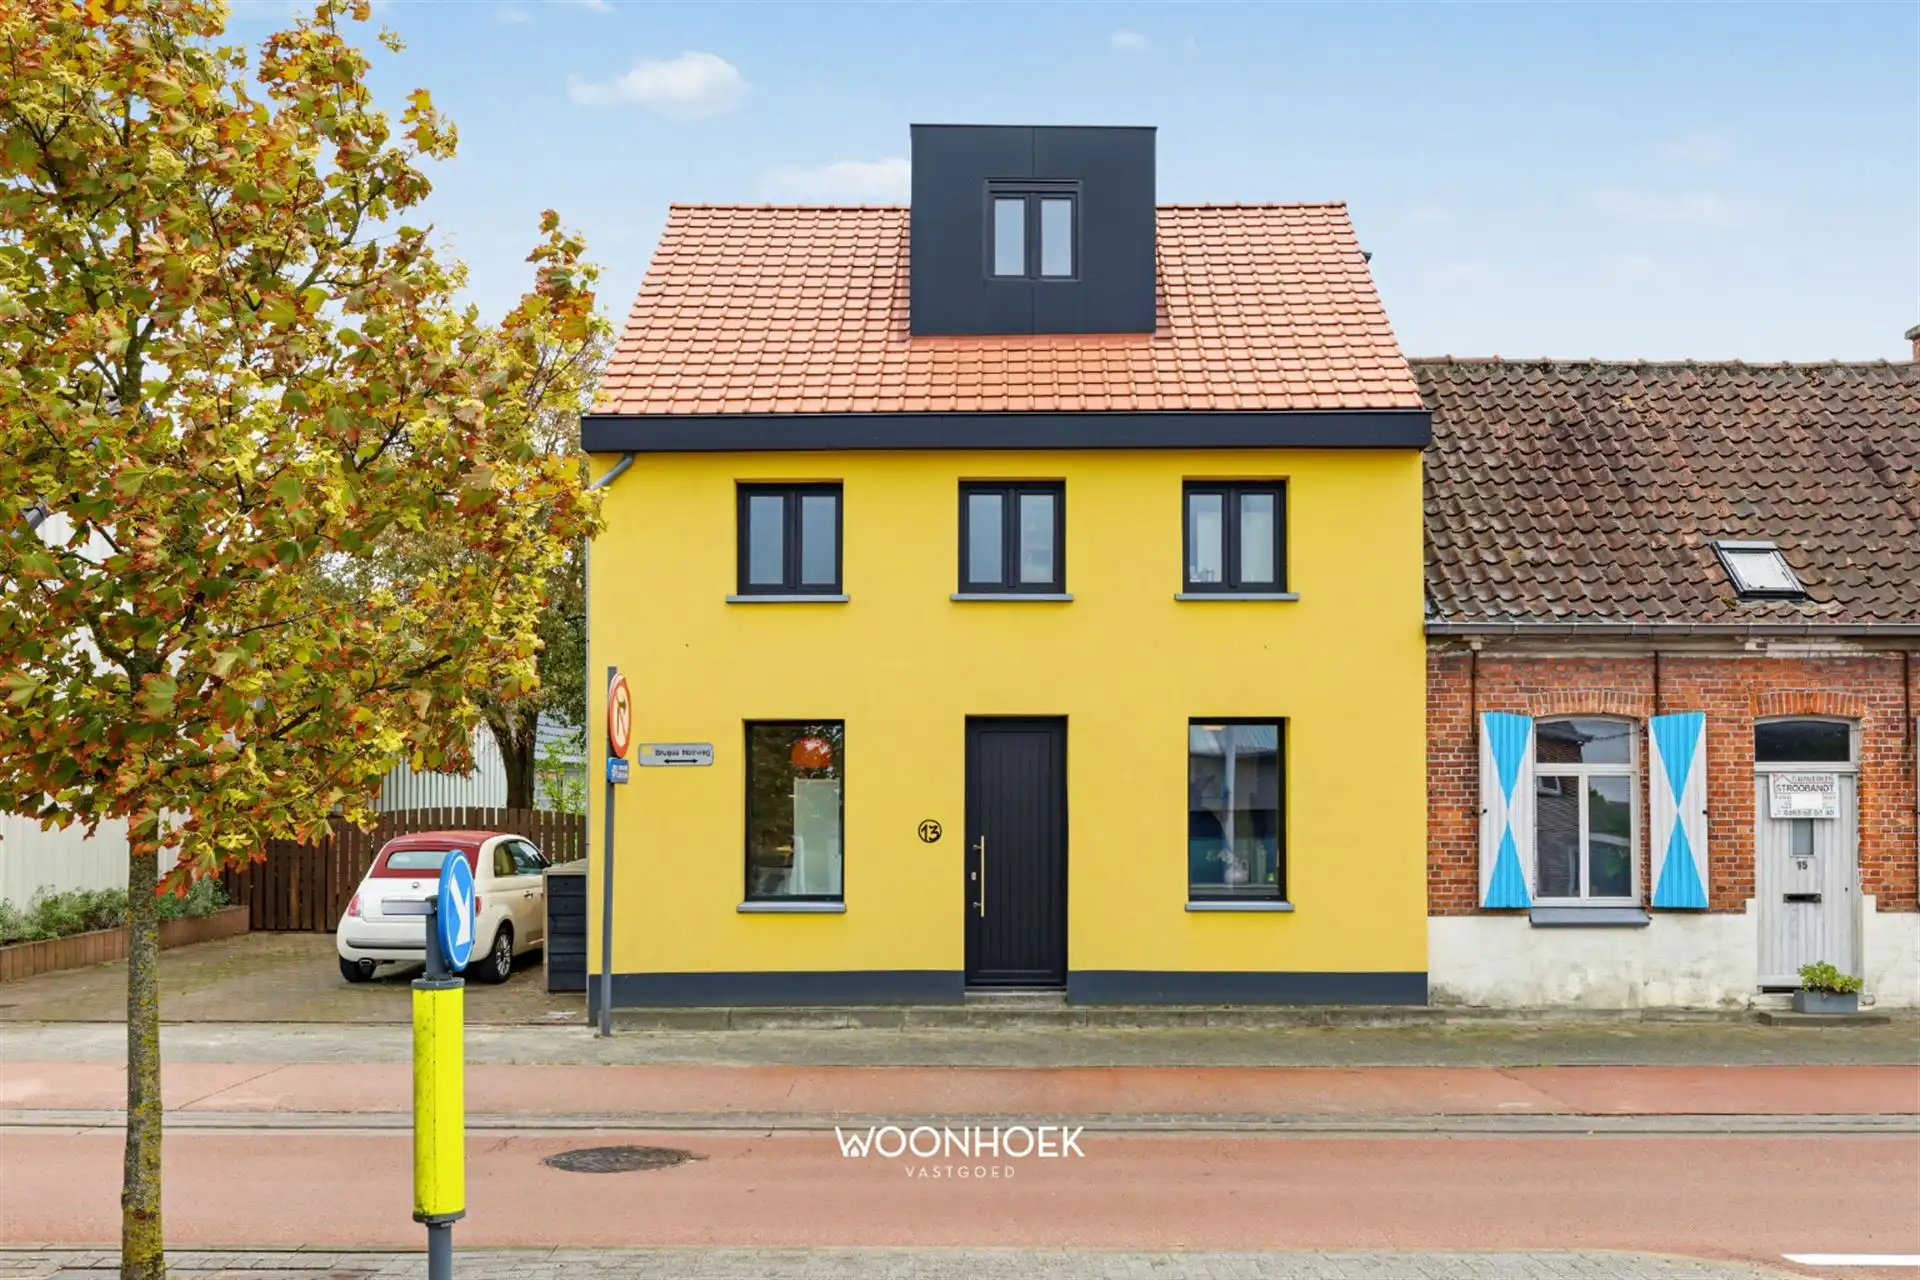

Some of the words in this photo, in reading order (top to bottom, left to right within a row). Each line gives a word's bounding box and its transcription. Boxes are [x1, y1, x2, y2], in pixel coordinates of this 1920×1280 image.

[1776, 784, 1834, 793] STROOBANDT
[921, 824, 940, 842] 13
[1796, 860, 1808, 871] 15
